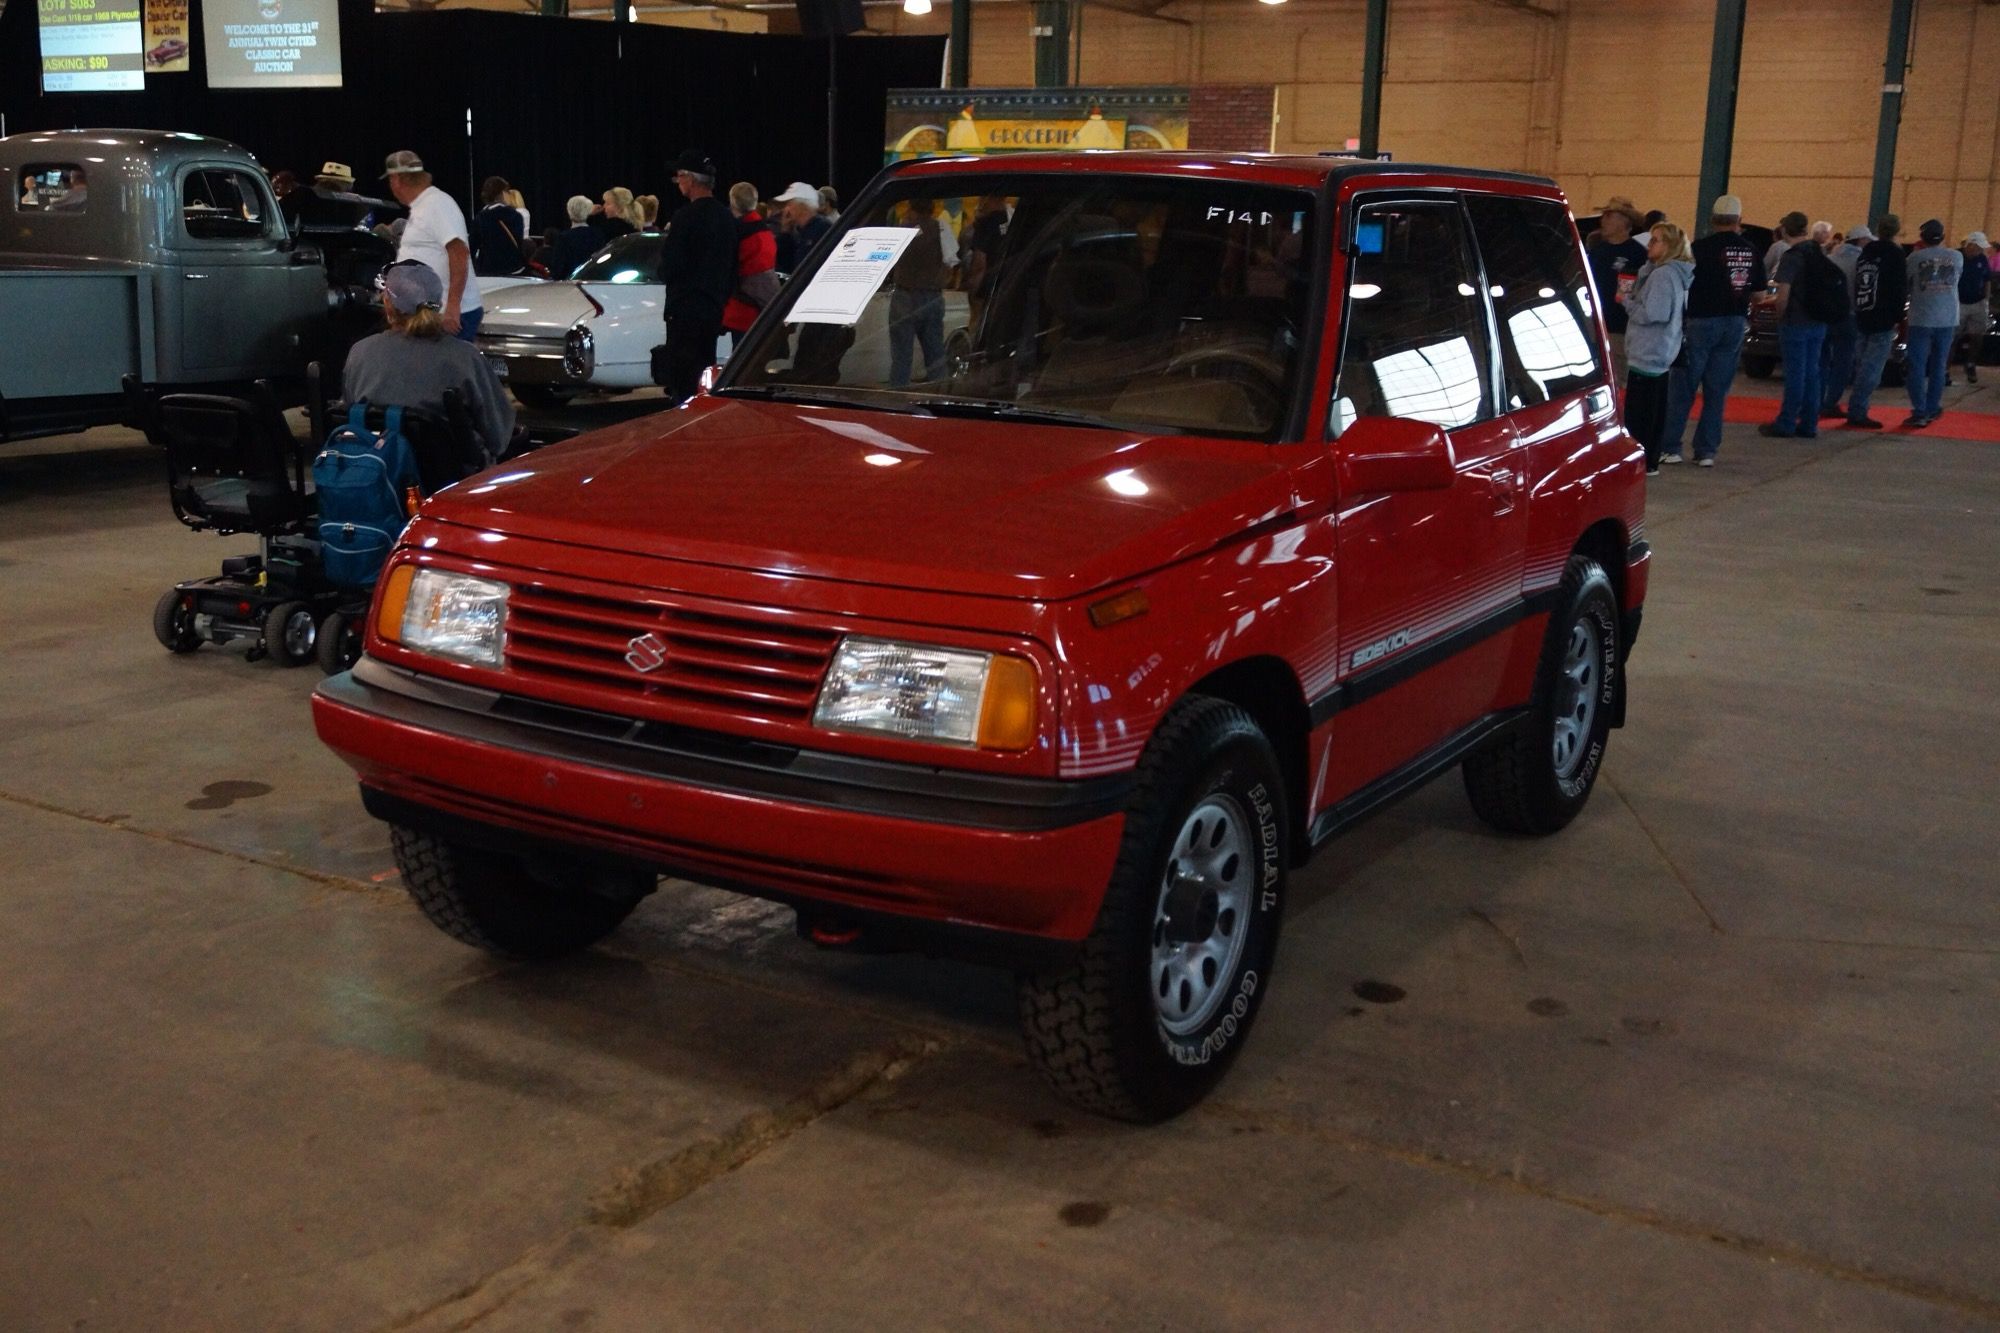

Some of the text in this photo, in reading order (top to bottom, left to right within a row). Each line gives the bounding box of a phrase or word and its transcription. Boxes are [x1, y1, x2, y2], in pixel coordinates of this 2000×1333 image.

[224, 24, 269, 35] WELCOME
[270, 24, 282, 34] TO
[284, 23, 300, 34] THE
[229, 35, 316, 48] ANNUAL TWIN CITIES
[246, 49, 301, 60] CLASSIC CAR
[44, 56, 108, 70] ASKING: $90
[254, 62, 294, 72] AUCTION
[1351, 628, 1412, 669] SIDEKICK
[1249, 783, 1279, 912] RADIAL
